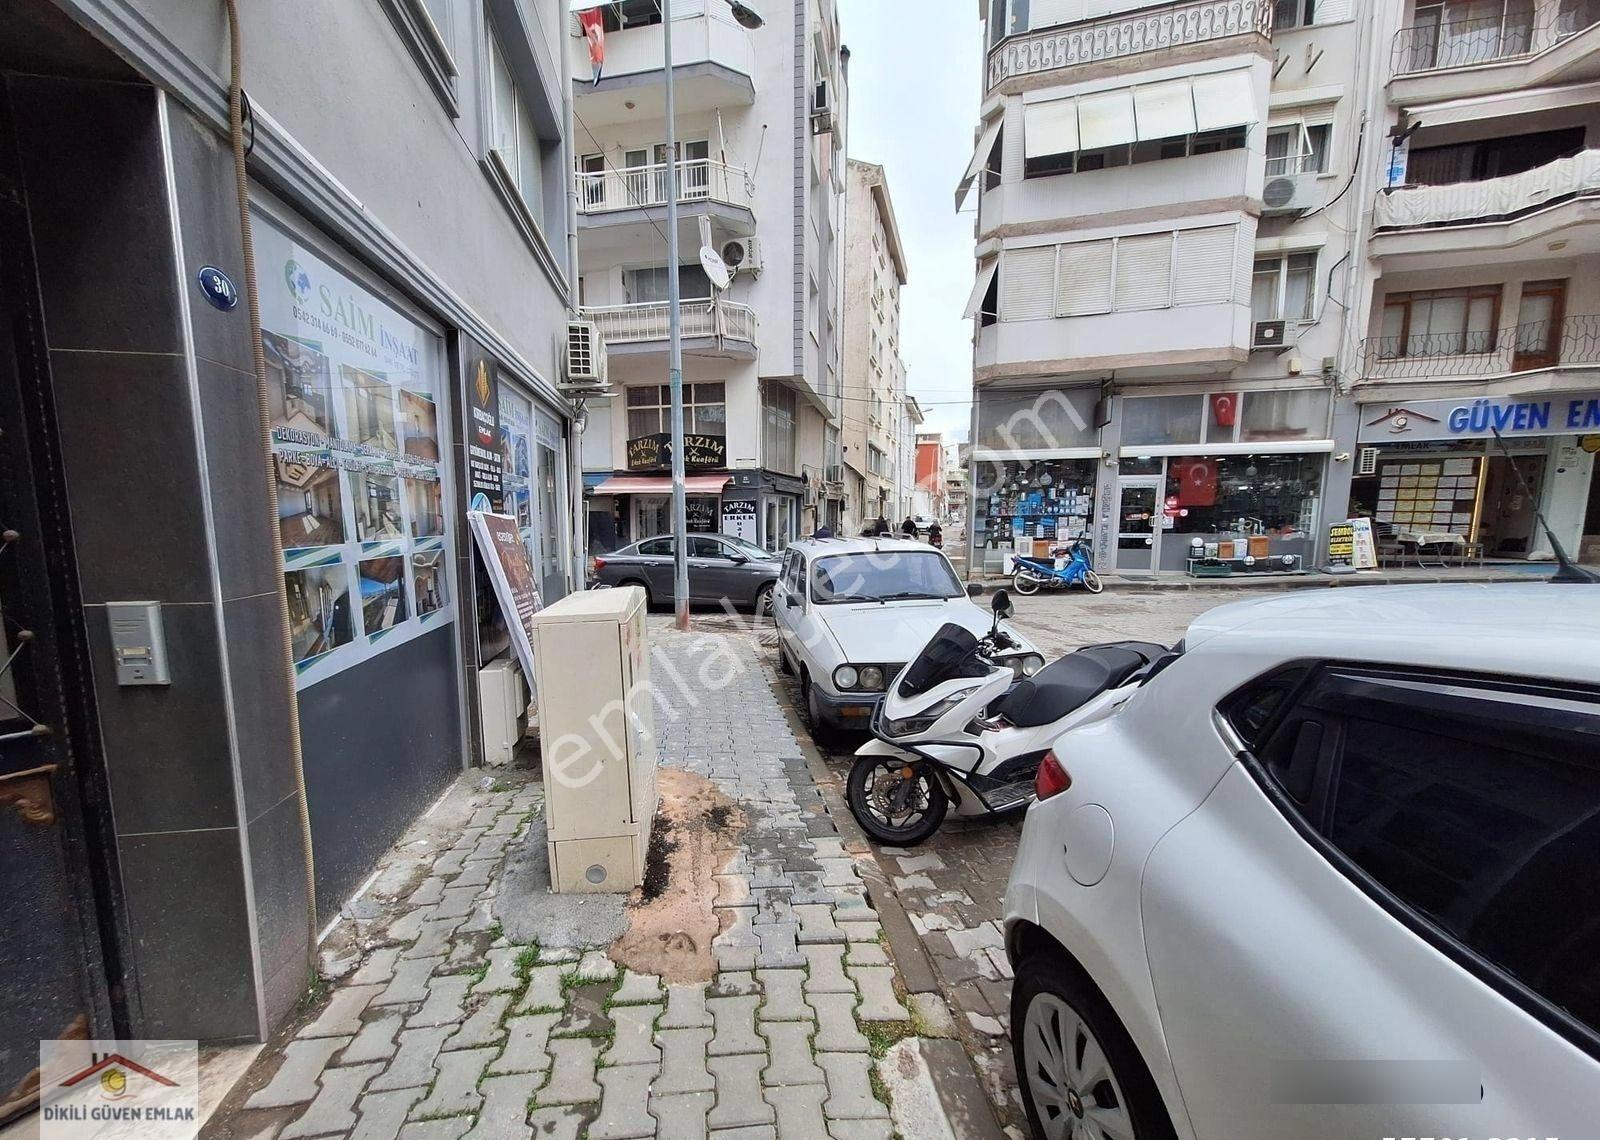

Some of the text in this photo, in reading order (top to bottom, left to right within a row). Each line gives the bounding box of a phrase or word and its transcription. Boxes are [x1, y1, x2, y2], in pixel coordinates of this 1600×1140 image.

[213, 275, 230, 298] 30
[319, 284, 376, 342] SAİM
[1447, 399, 1551, 434] GÜVEN
[276, 425, 320, 448] DEKORASYON
[664, 436, 725, 455] TRZIM
[724, 502, 755, 513] TARZIM
